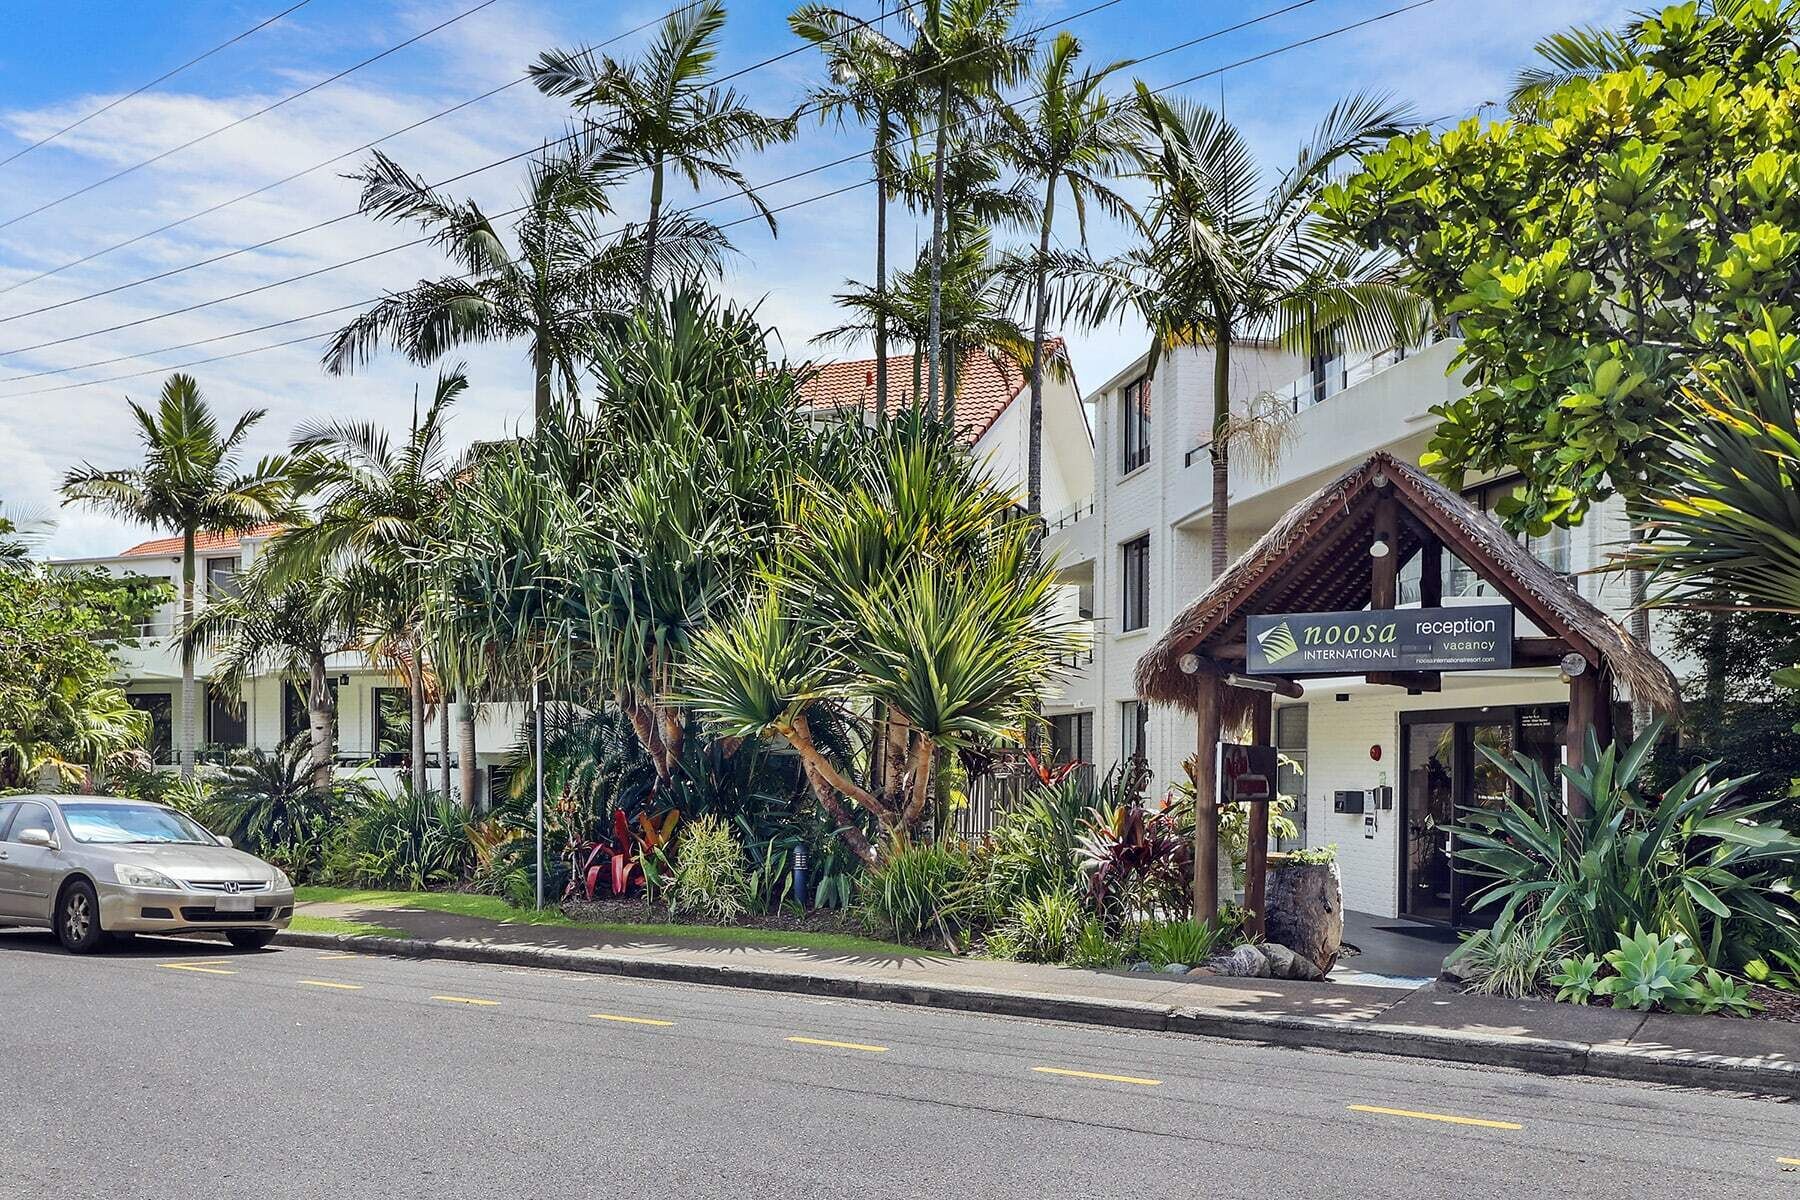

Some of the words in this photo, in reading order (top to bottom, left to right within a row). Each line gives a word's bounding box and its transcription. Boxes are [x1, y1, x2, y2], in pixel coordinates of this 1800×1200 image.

[1304, 623, 1397, 645] noosa
[1415, 618, 1496, 637] reception
[1443, 640, 1496, 652] vacancy
[1304, 648, 1397, 660] INTERNATIONAL
